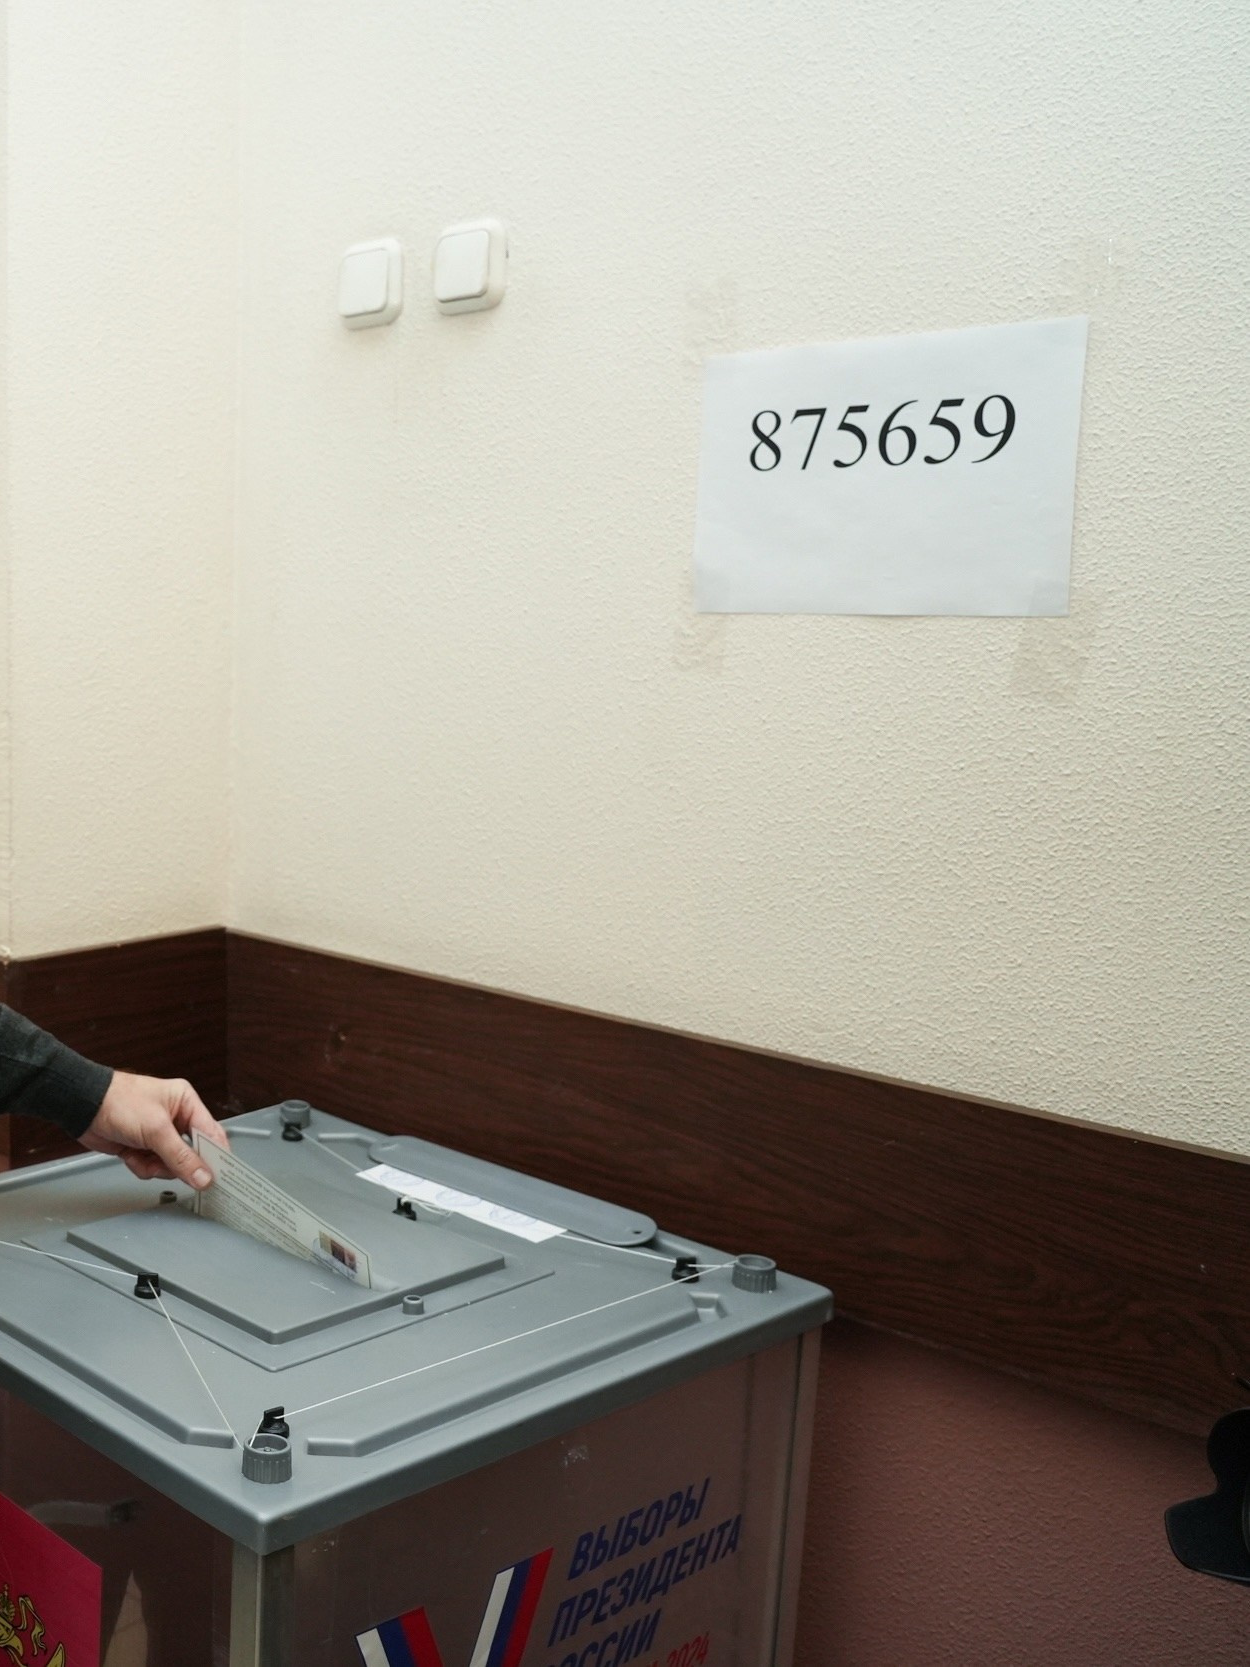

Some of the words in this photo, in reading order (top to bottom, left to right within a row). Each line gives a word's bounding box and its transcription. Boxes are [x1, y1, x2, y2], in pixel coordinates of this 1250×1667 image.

[749, 394, 1017, 472] 875659
[547, 1513, 743, 1648] ПРЕЗИДЕНТА
[567, 1476, 710, 1581] ВЫБОРЫ
